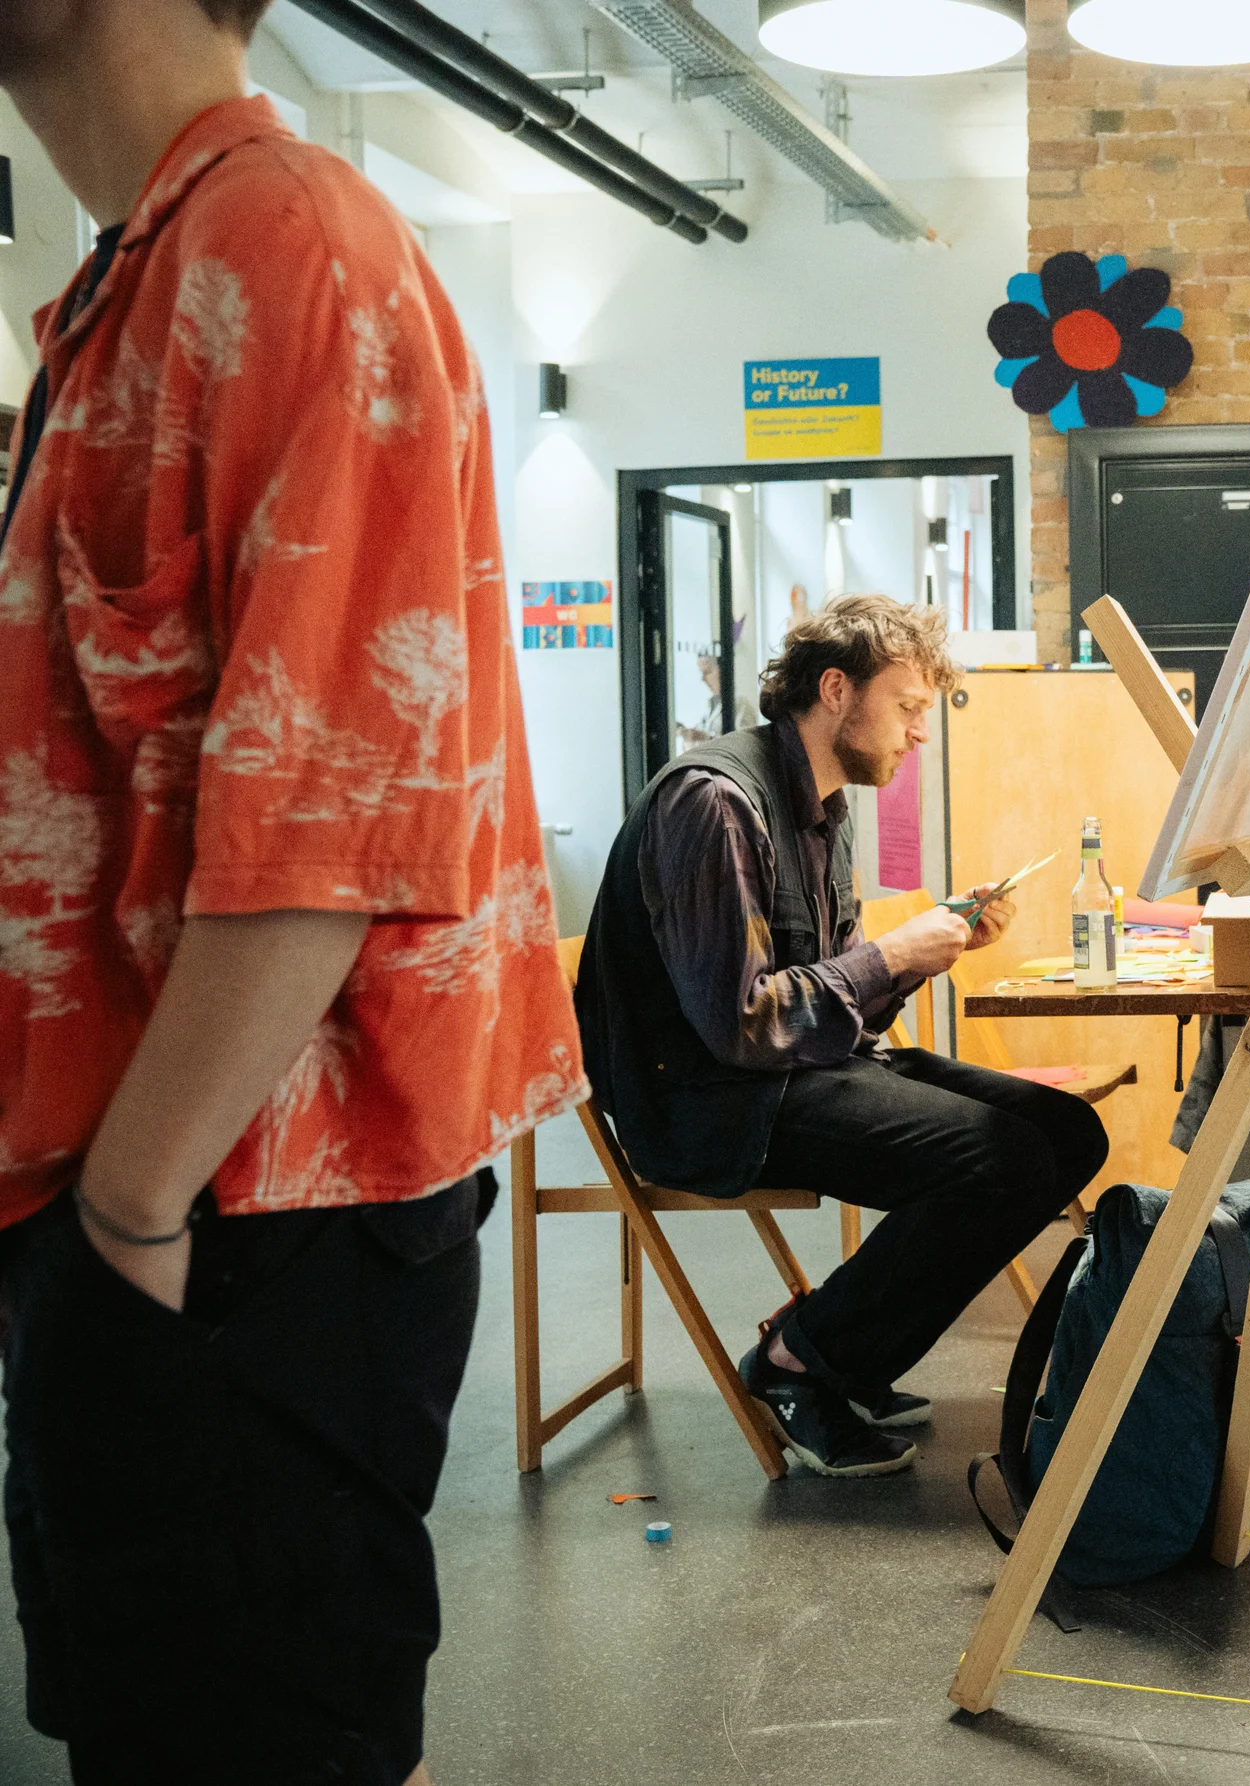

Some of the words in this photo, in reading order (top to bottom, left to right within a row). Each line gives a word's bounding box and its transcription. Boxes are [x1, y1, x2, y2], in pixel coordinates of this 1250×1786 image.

[752, 367, 818, 387] History
[752, 389, 771, 402] or
[778, 382, 848, 402] Future?
